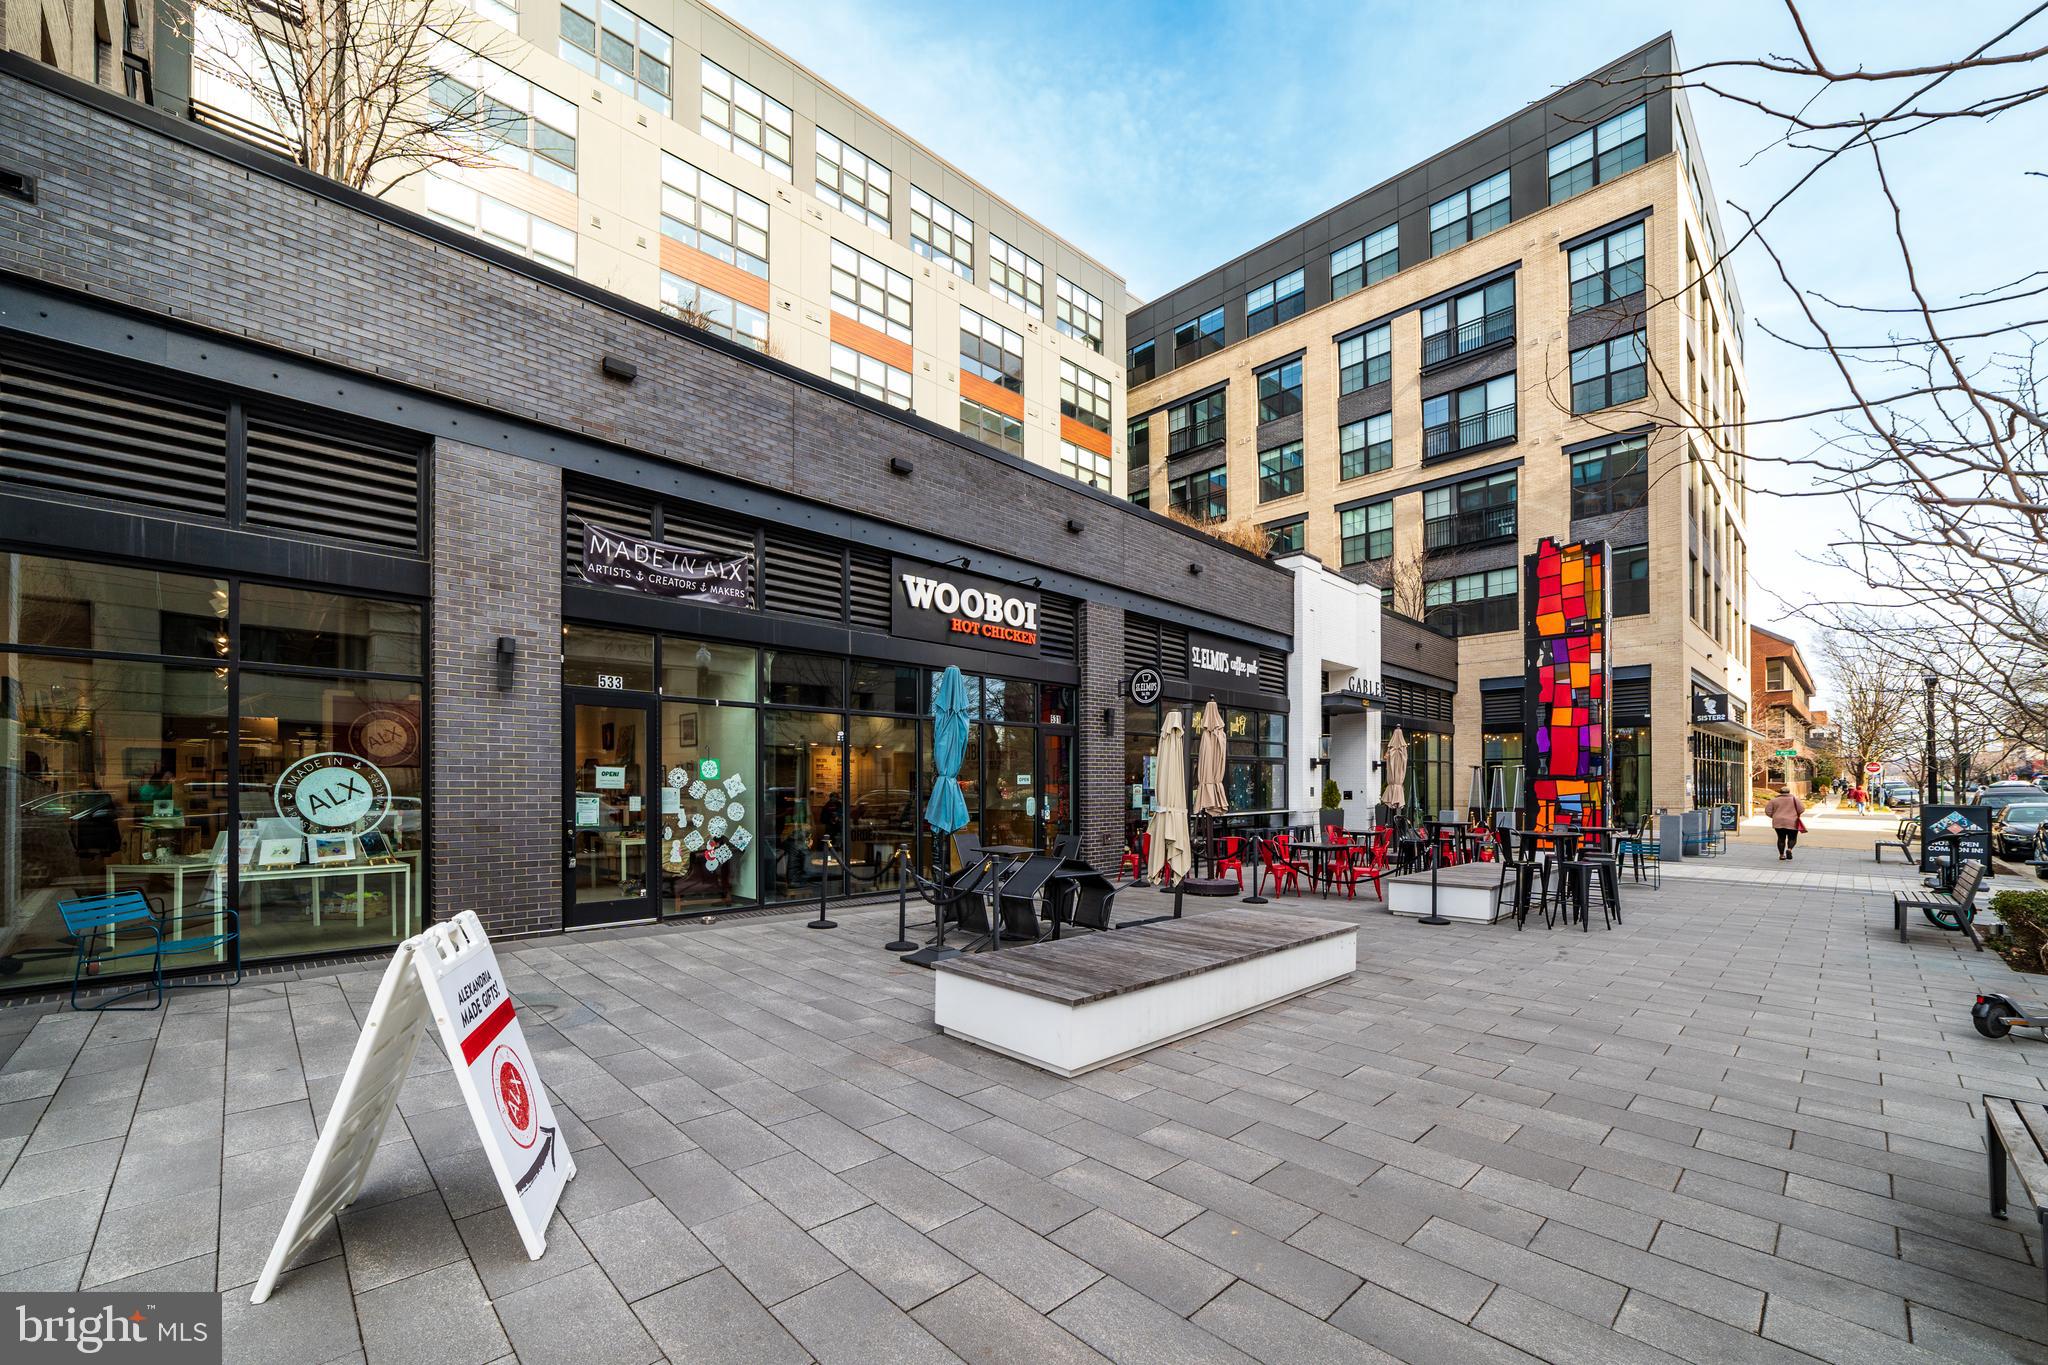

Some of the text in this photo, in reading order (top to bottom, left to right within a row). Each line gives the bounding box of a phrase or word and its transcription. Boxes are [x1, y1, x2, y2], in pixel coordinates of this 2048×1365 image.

[590, 535, 743, 582] MADE IN ALX
[587, 563, 745, 598] ARTISTS CREATORS MAKERS
[903, 574, 1037, 630] WOOBOI
[951, 618, 1037, 645] HOT CHICKEN
[1201, 648, 1229, 673] ELMO'S
[1231, 656, 1246, 676] coffee
[1247, 660, 1258, 677] pub
[600, 676, 622, 689] 533
[368, 726, 402, 749] ALX
[287, 757, 343, 786] MADE IN
[309, 777, 366, 815] ALX
[458, 970, 492, 1005] ALEXANDRIA
[461, 980, 500, 1028] MADE GIFTS!
[508, 1069, 521, 1123] ALX
